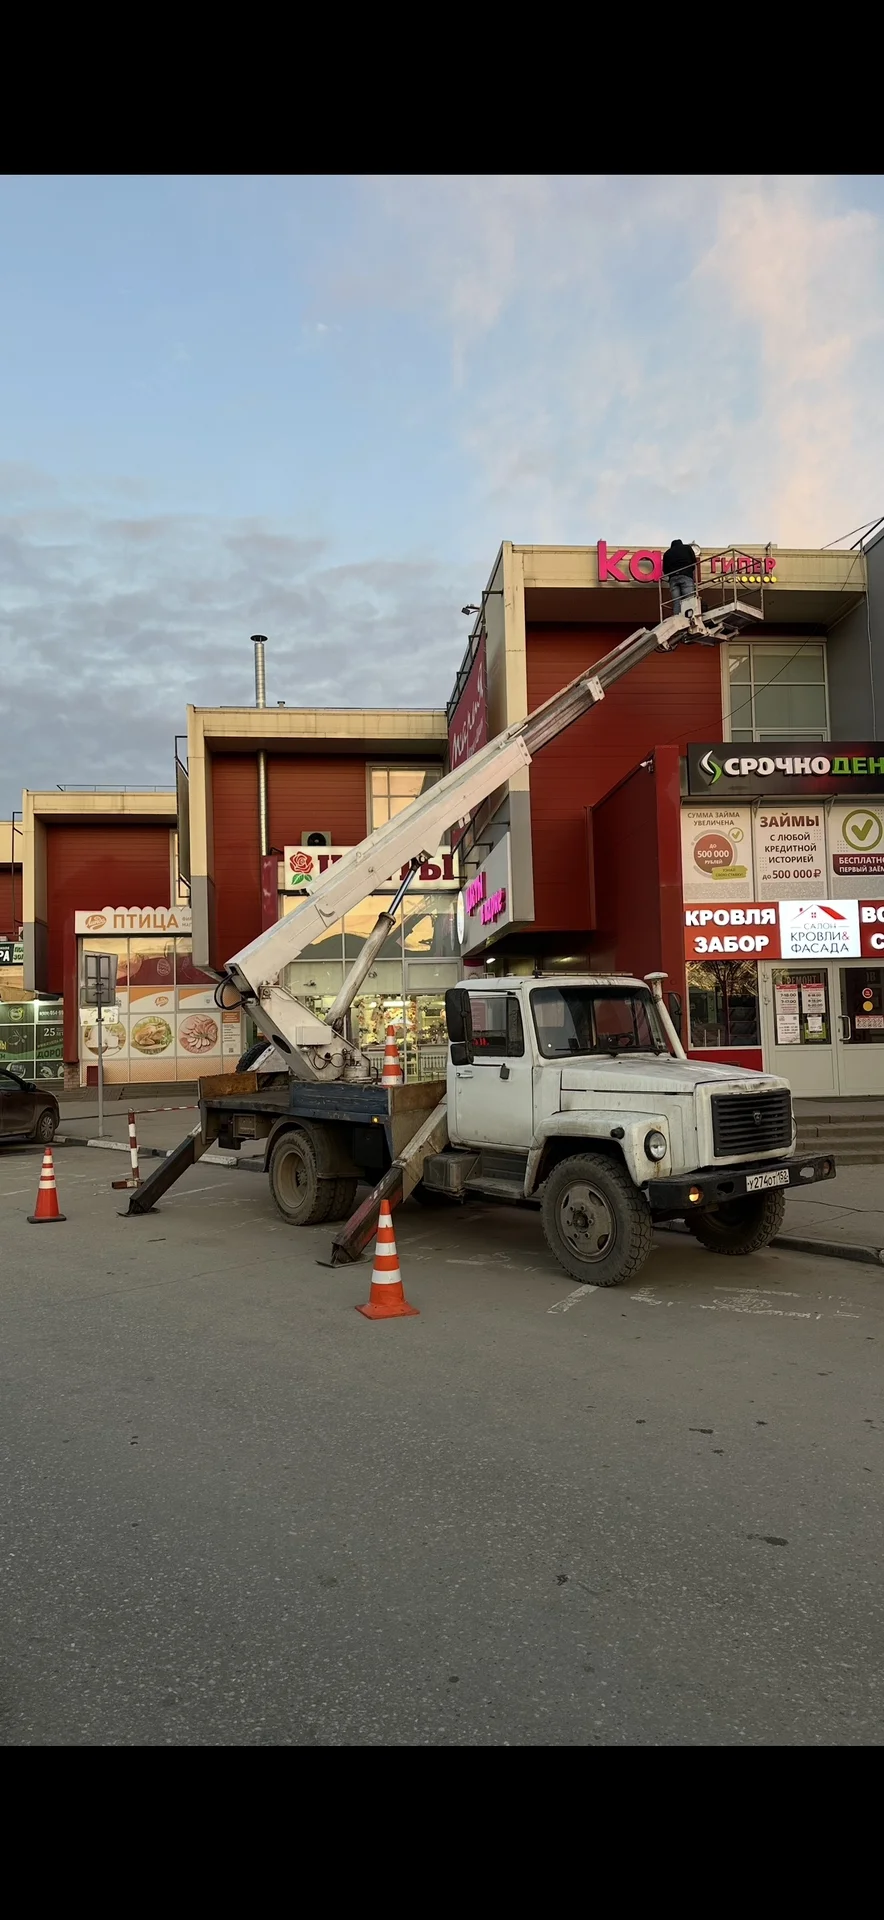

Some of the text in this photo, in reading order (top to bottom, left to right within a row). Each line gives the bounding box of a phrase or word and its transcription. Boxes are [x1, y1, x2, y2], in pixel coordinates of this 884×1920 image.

[711, 556, 776, 574] ГИПЕР
[715, 810, 740, 818] ЗАЙМА
[760, 812, 820, 828] ЗАЙМЫ
[769, 831, 811, 842] С ЛЮБОЙ
[697, 850, 730, 858] 500 000
[764, 843, 817, 854] КРЕДИТНОЙ
[768, 854, 814, 863] ИСТОРИЕЙ
[839, 856, 884, 864] БЕСПЛАТН
[840, 864, 868, 873] ПЕРВЫЙ
[772, 870, 791, 879] 500
[113, 913, 179, 931] ПТИЦА
[684, 908, 776, 926] КРОВЛЯ
[694, 935, 770, 953] ЗАБОР
[790, 942, 850, 954] ФАСАДА
[43, 1028, 56, 1037] 25
